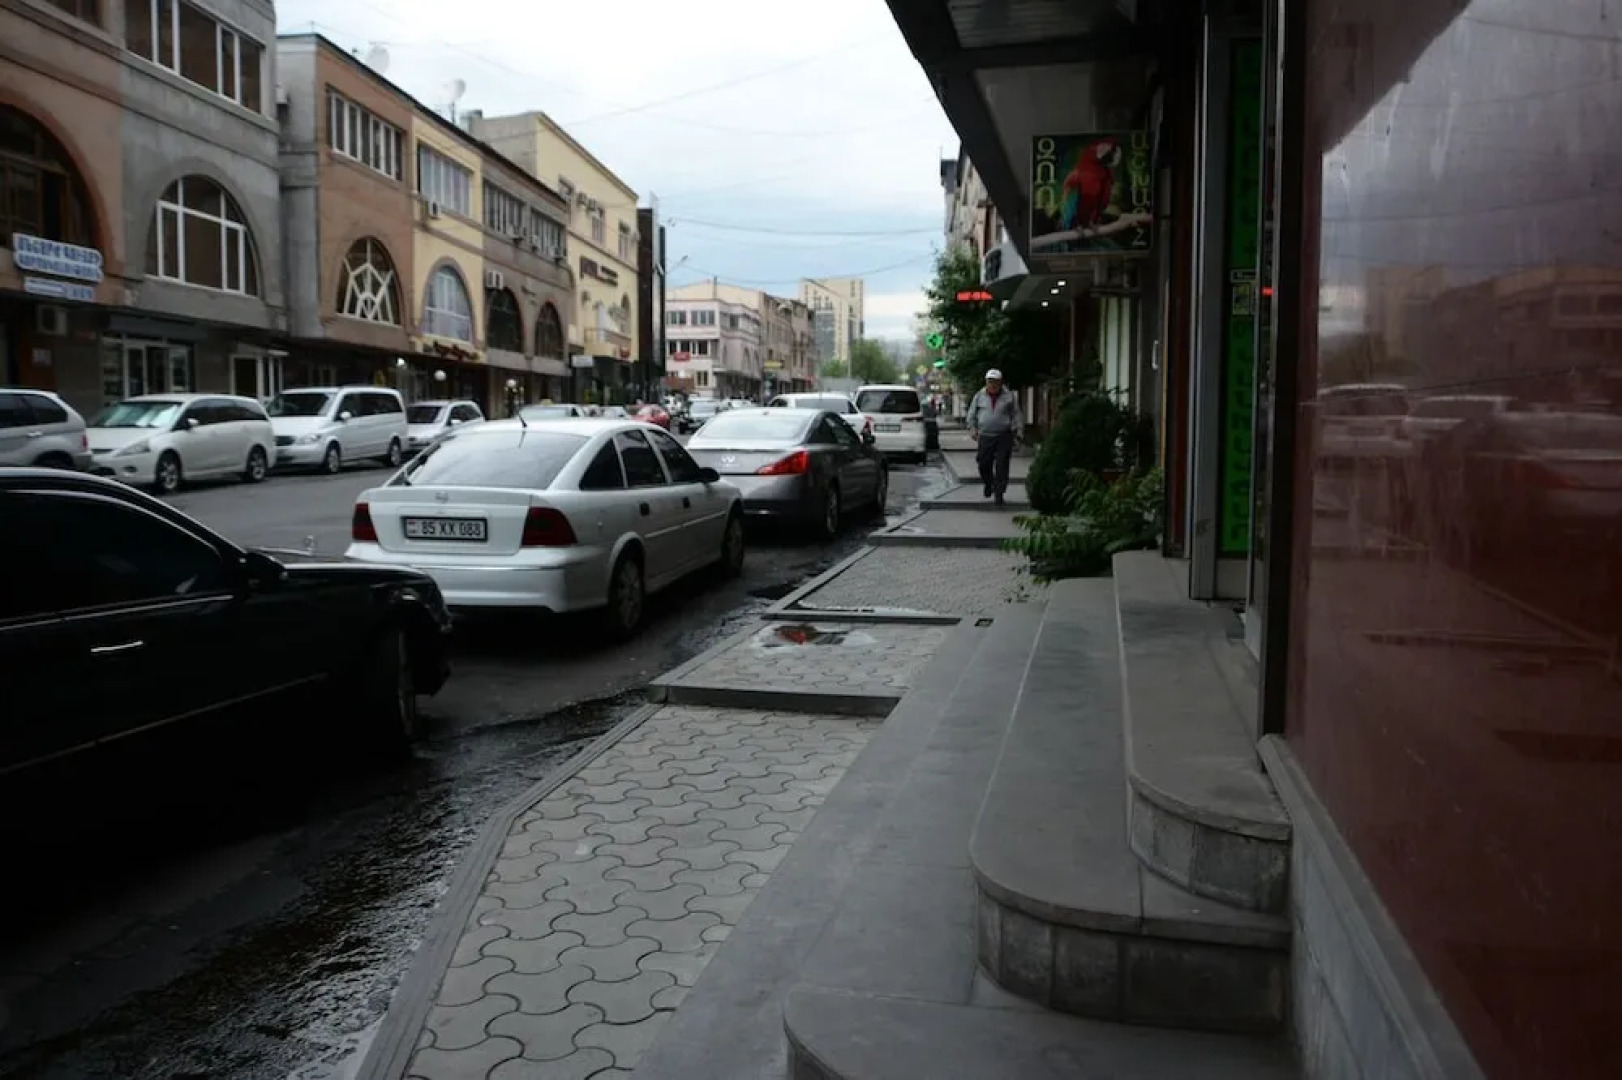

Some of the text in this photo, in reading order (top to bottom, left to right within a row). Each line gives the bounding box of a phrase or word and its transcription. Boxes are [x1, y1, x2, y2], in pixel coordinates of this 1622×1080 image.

[422, 521, 481, 537] 85 XX 088
